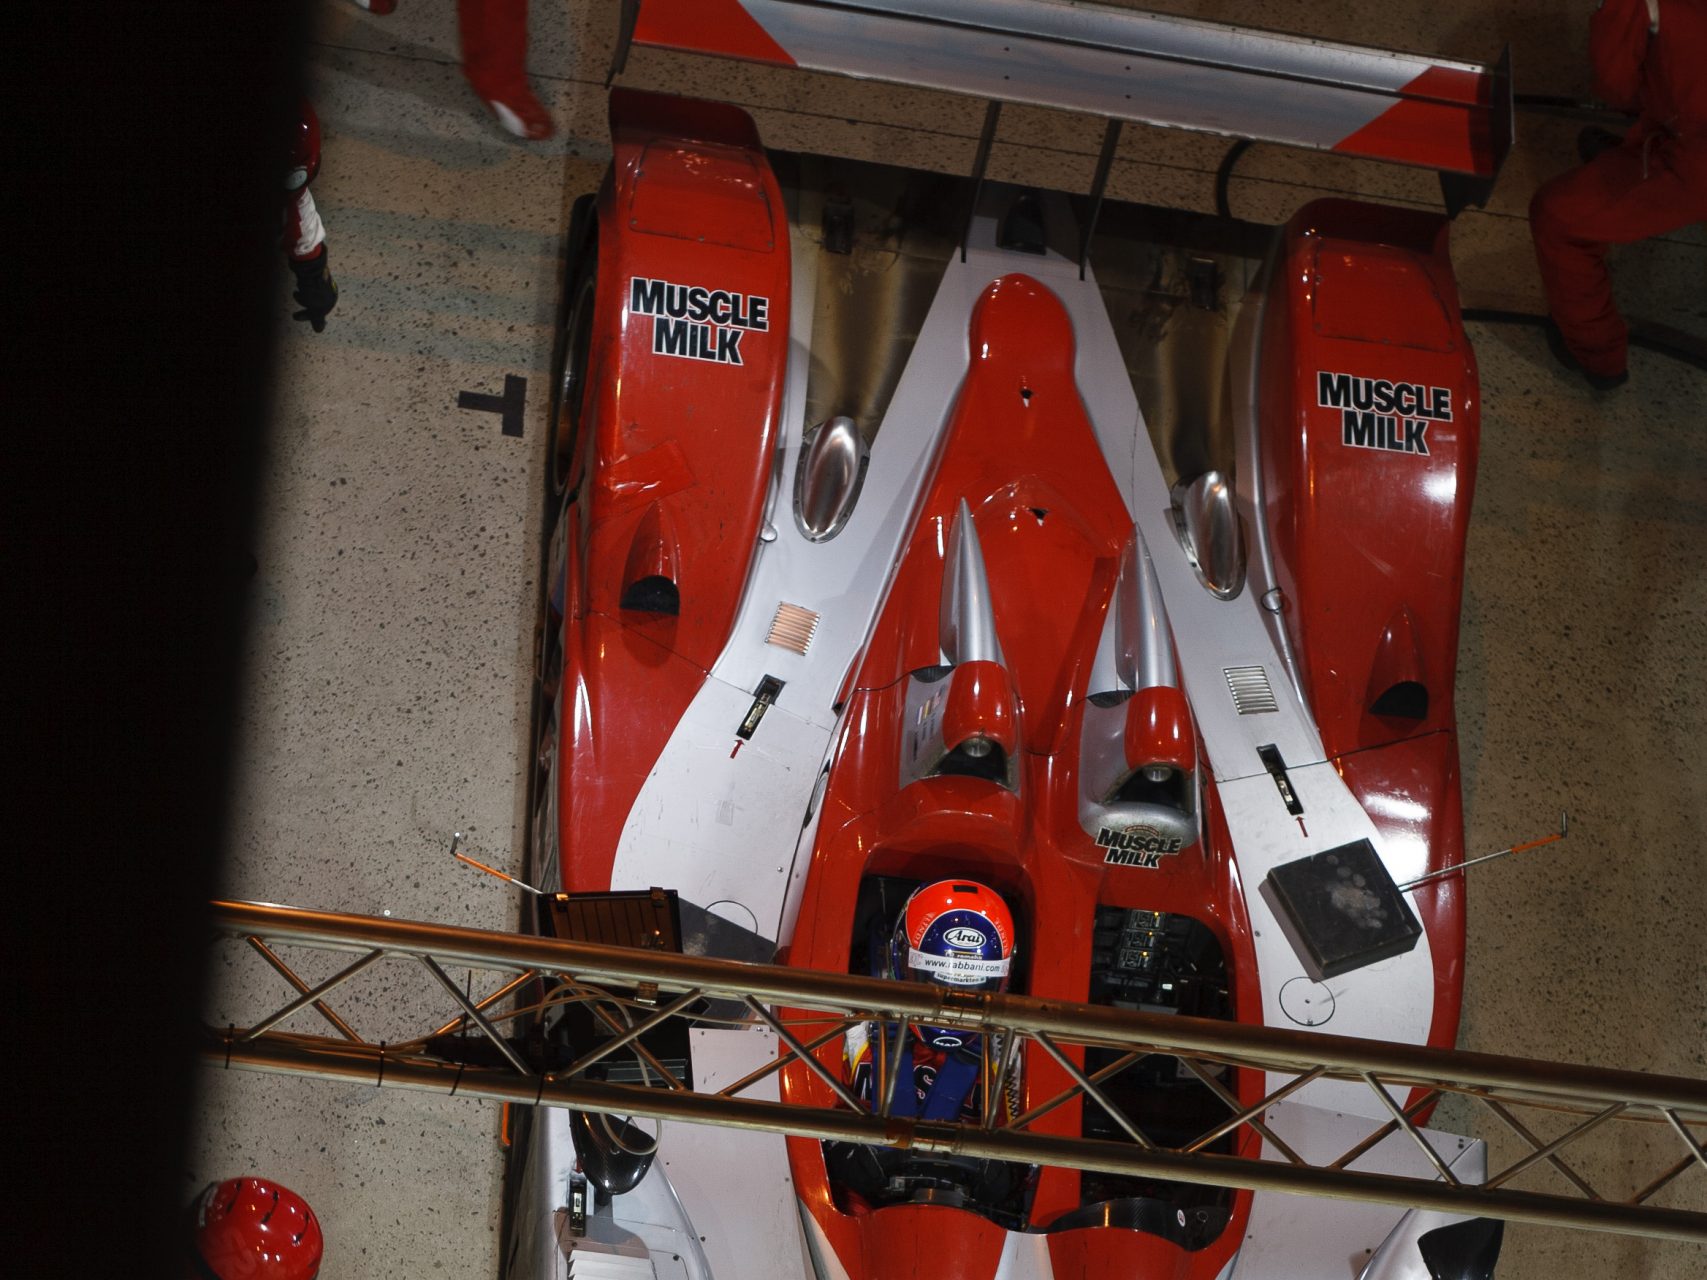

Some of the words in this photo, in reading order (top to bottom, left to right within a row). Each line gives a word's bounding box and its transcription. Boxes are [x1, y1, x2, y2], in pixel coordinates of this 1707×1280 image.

[630, 277, 769, 331] MUSCLE
[653, 315, 744, 365] MILK
[1317, 371, 1453, 422] MUSCLE
[1342, 409, 1430, 456] MILK
[1096, 827, 1182, 855] MUSCLE
[1104, 848, 1159, 869] MILK
[946, 931, 981, 943] Arai
